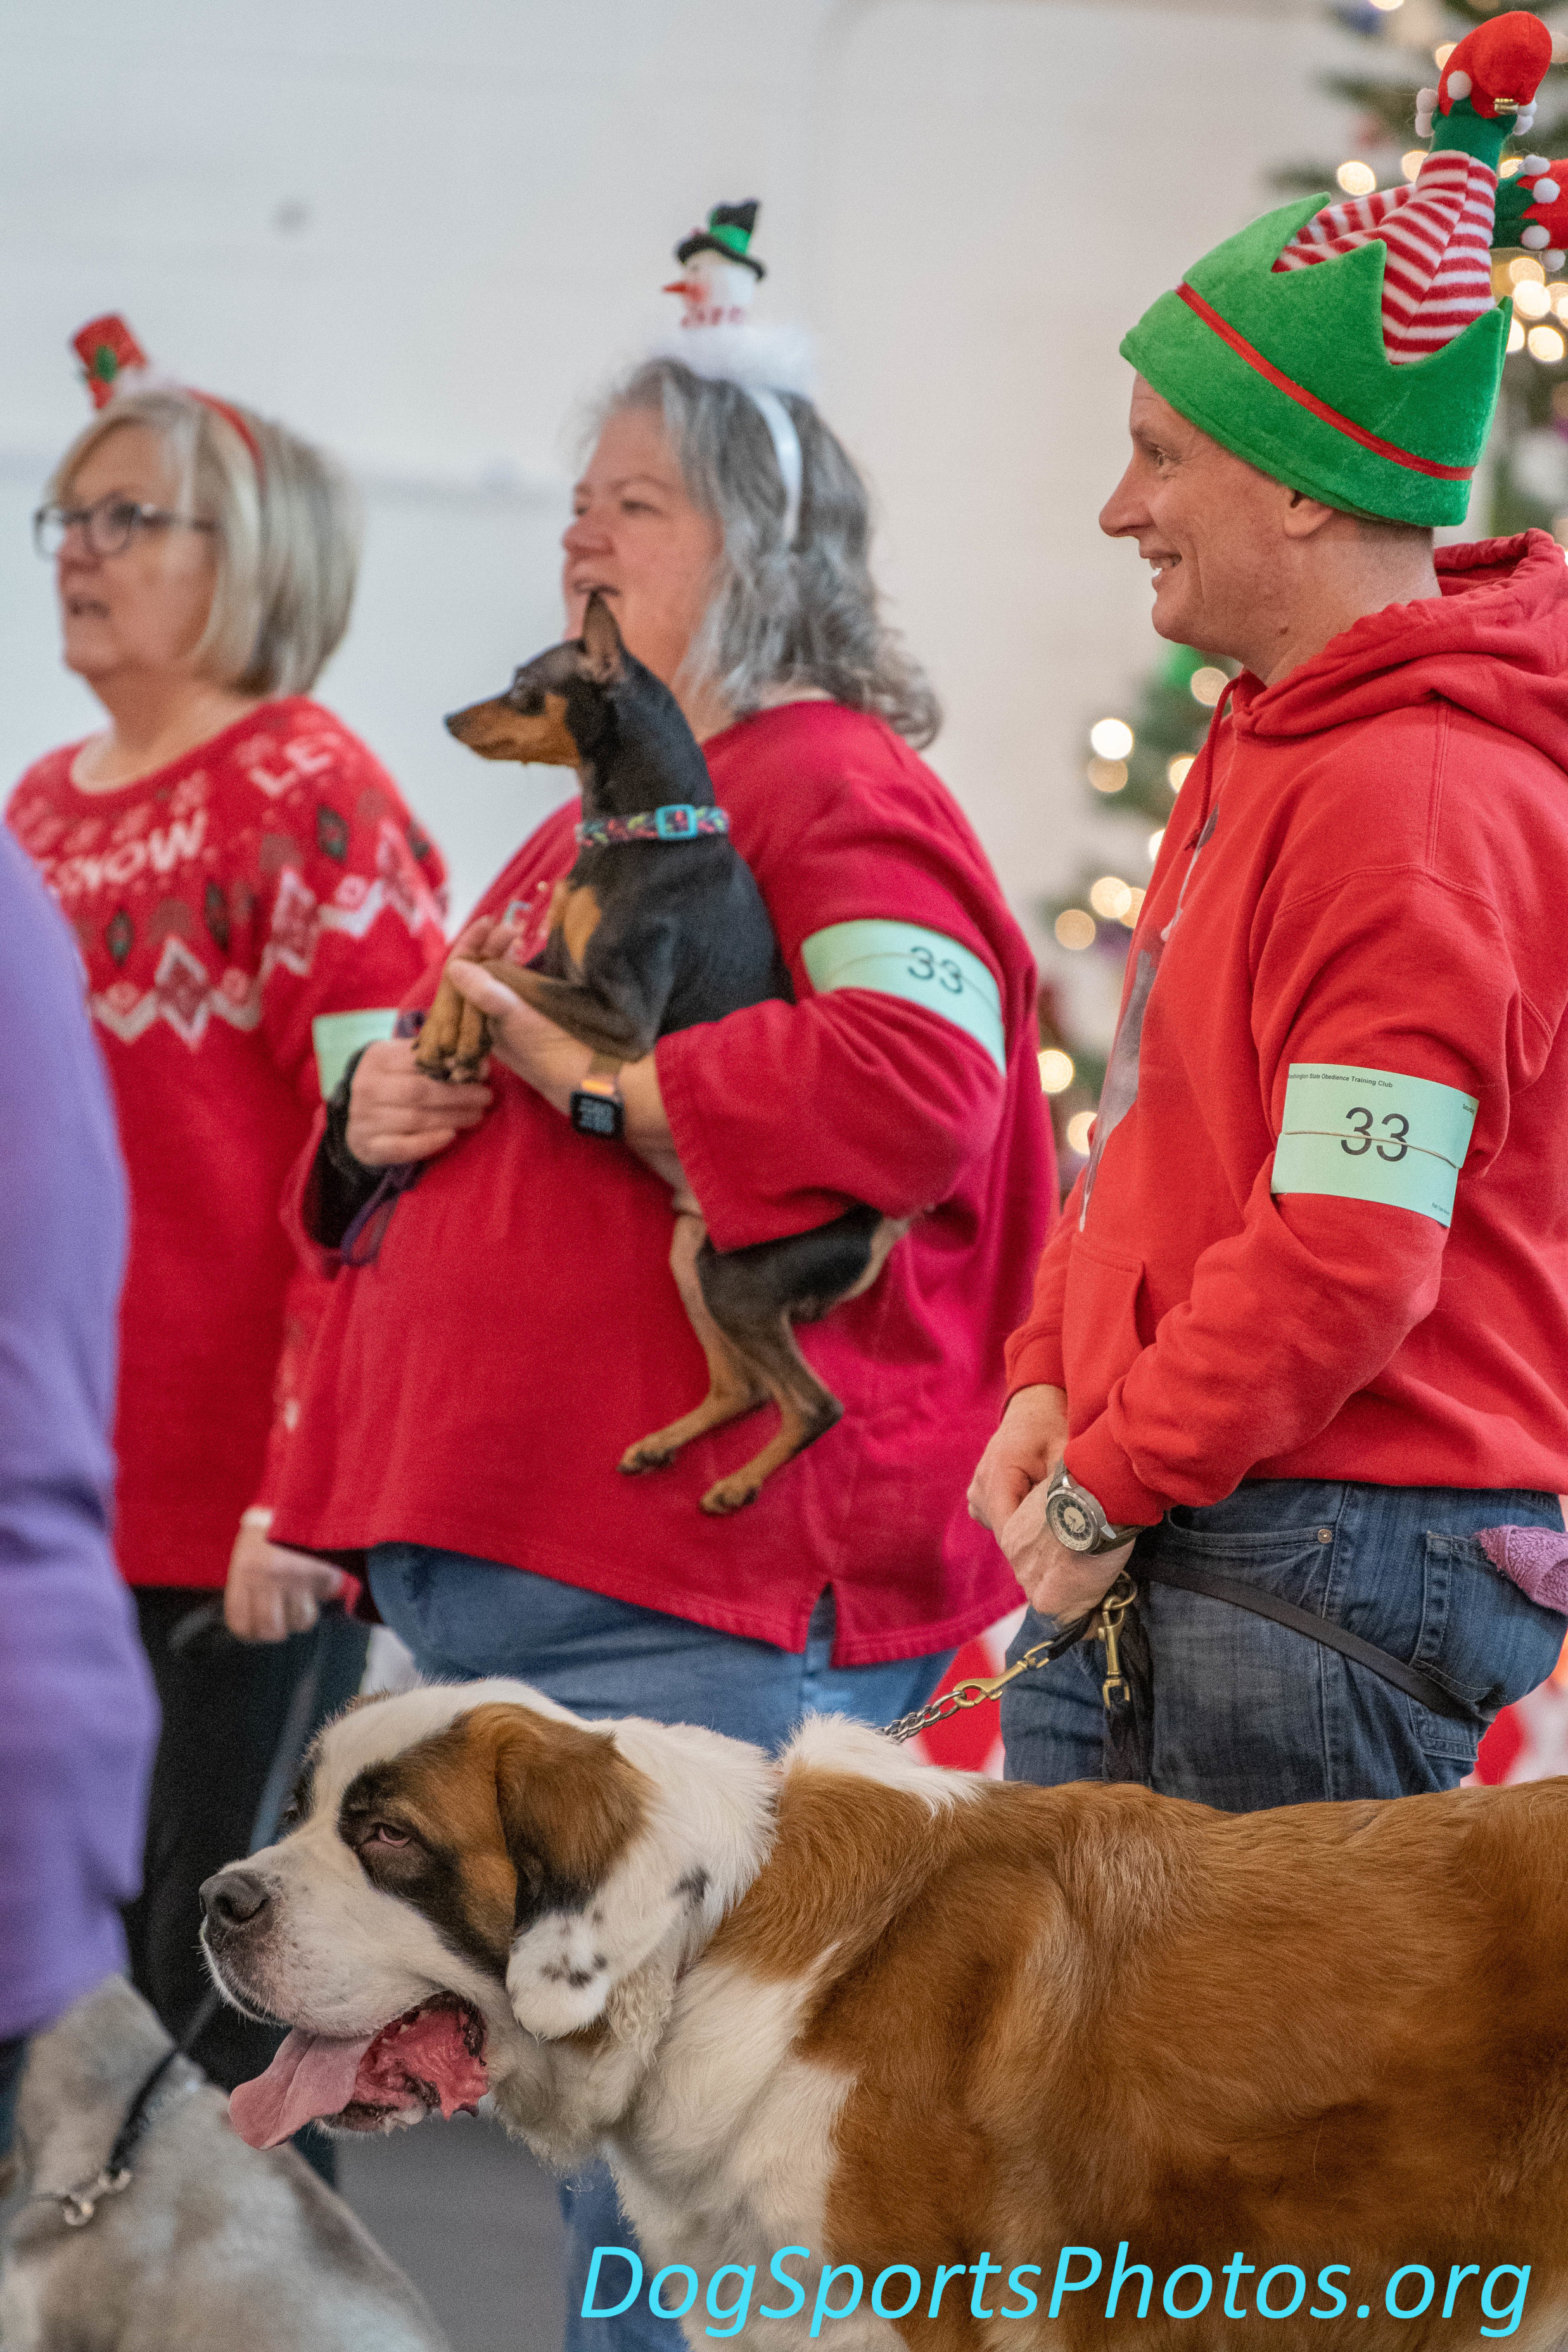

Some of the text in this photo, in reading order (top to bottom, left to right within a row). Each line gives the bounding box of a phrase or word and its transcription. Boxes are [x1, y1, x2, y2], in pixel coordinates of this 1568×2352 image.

[907, 946, 963, 994] 33
[1322, 1073, 1350, 1082] Obedience
[1351, 1076, 1377, 1086] Training
[1341, 1106, 1410, 1162] 33
